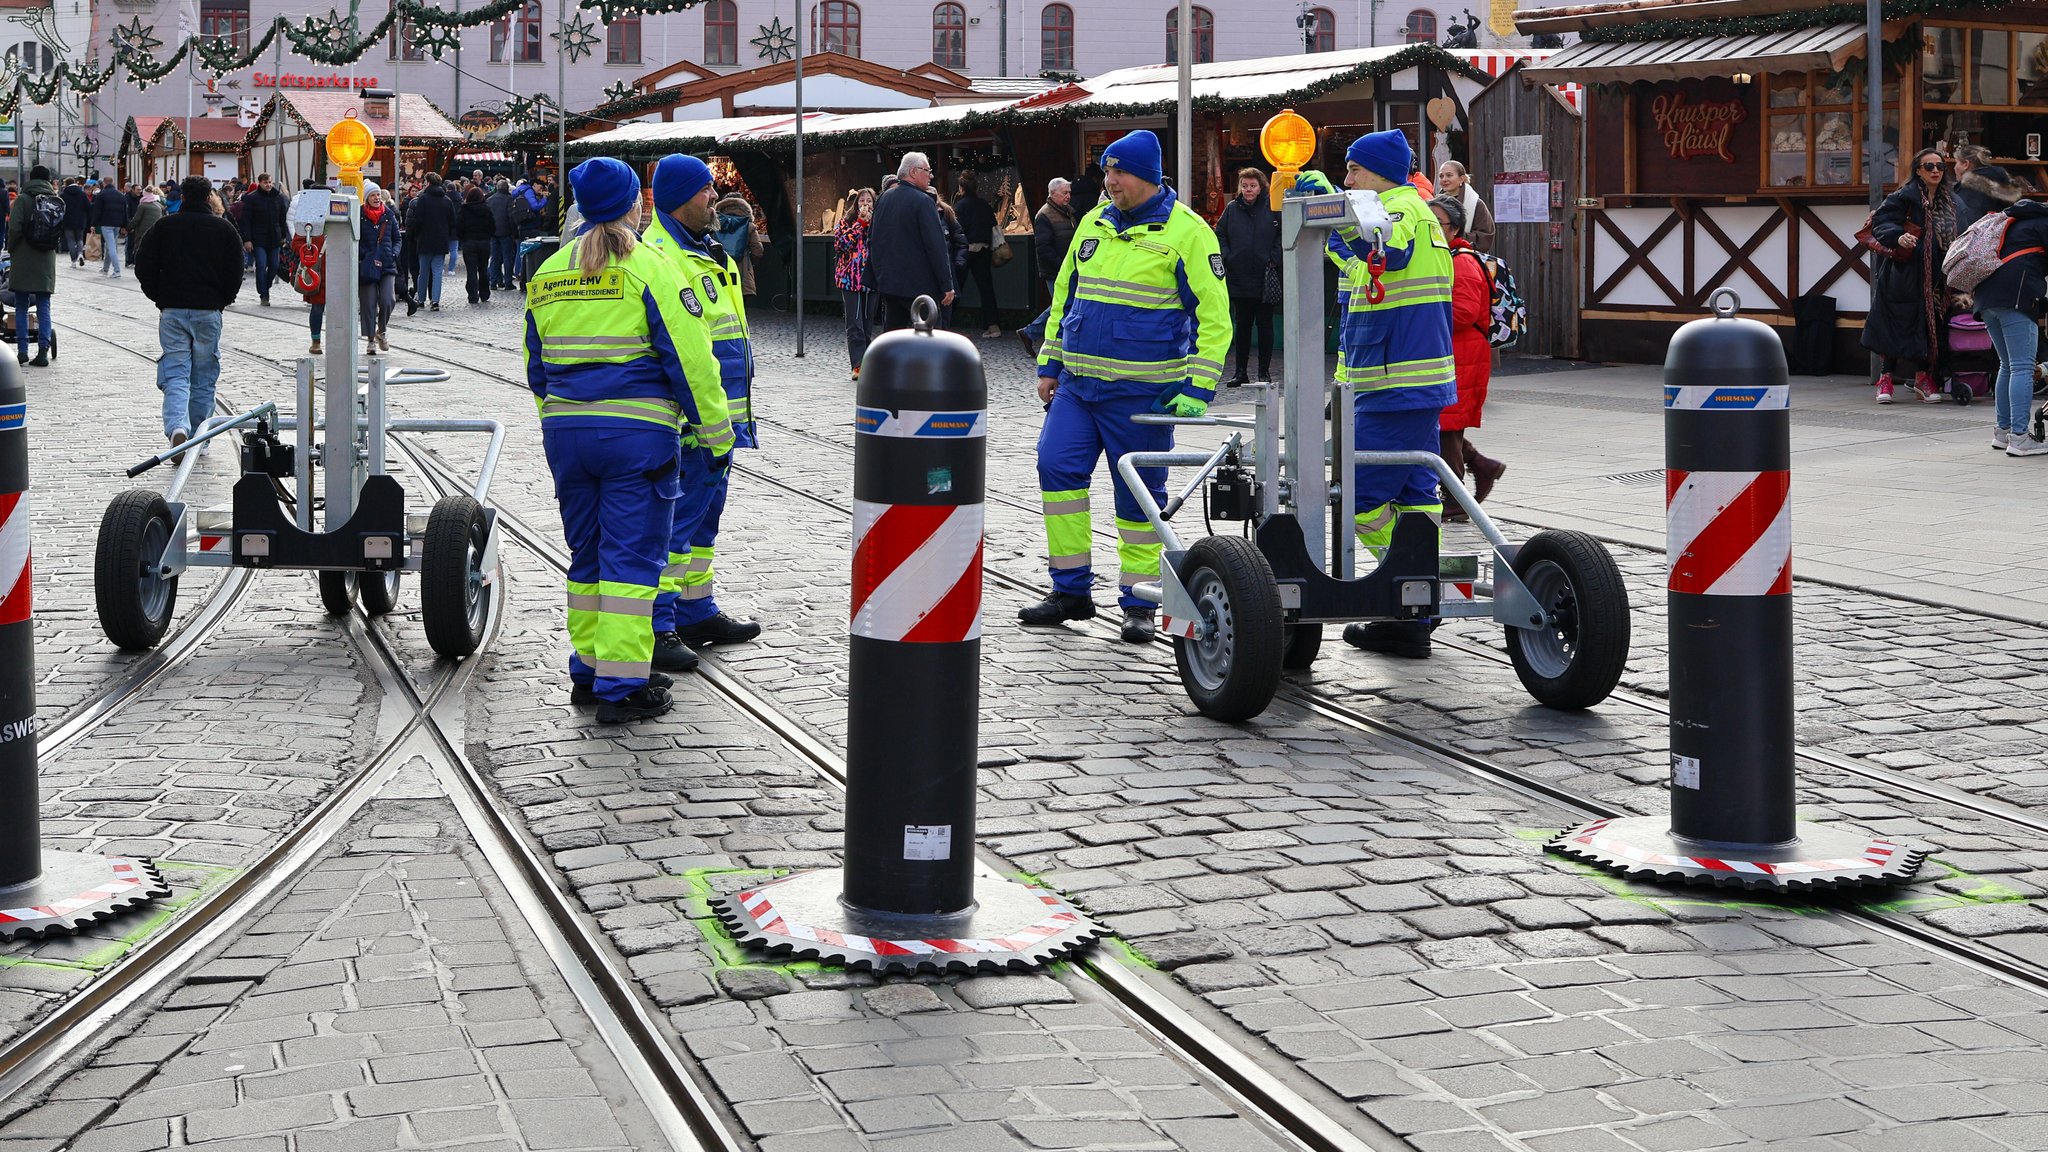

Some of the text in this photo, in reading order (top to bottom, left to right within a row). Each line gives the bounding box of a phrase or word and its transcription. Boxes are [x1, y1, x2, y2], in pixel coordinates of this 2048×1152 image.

[253, 72, 378, 90] Stadtsparkasse
[1652, 95, 1741, 130] Knusper
[1664, 122, 1729, 160] Häusl
[542, 275, 602, 292] Agentur EMV
[531, 288, 620, 306] SECURITY-SICHERHEITSDIENST
